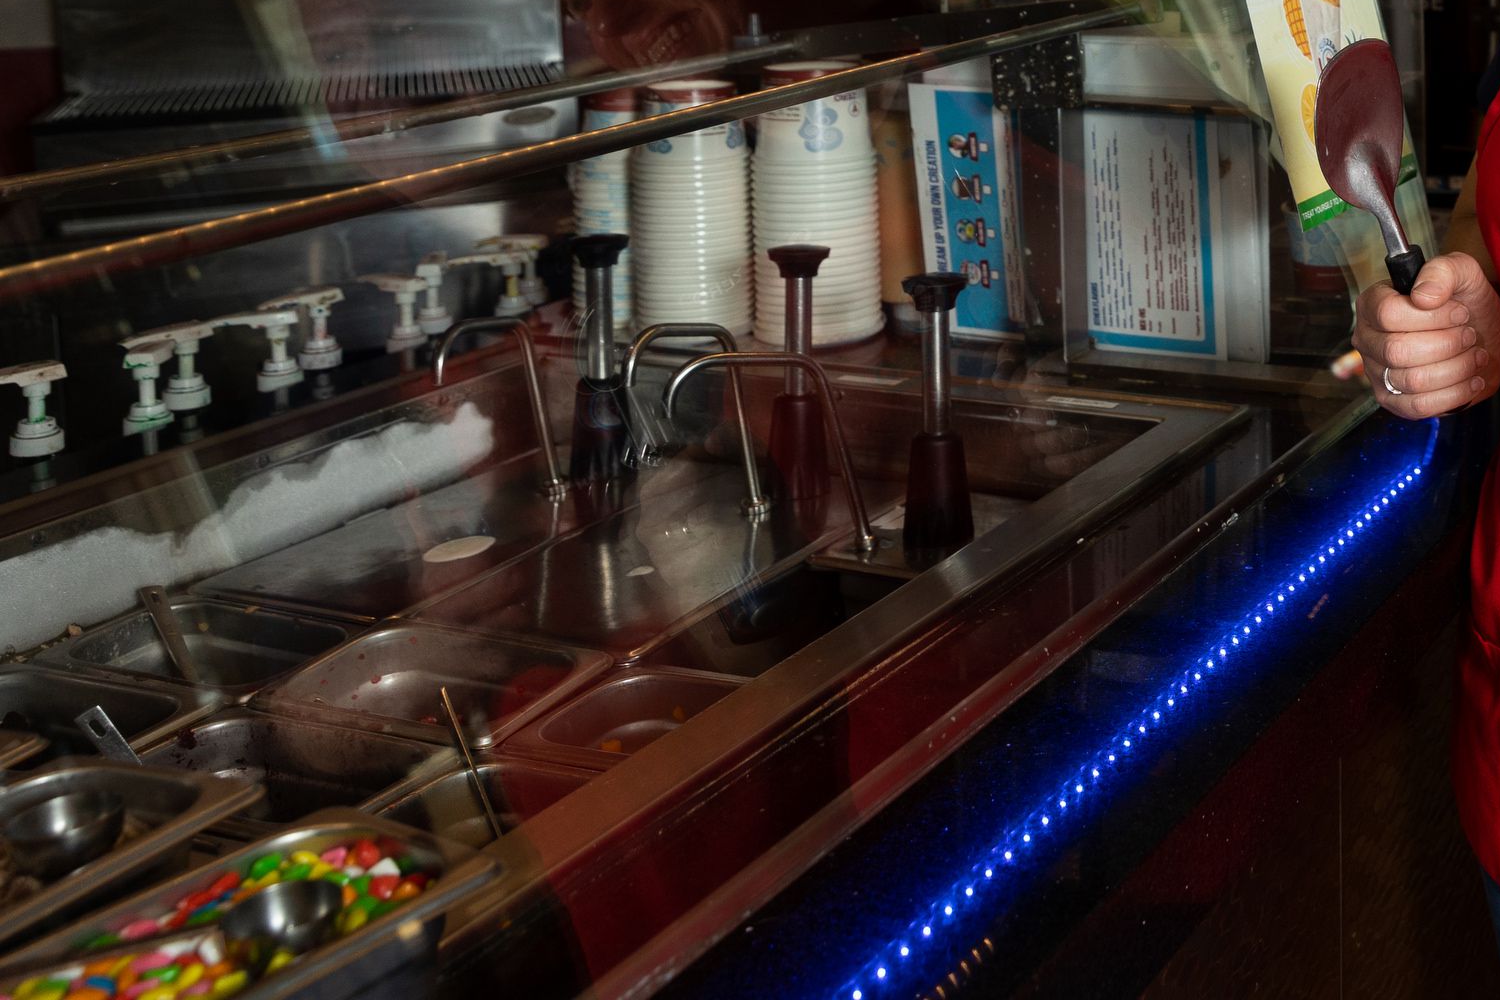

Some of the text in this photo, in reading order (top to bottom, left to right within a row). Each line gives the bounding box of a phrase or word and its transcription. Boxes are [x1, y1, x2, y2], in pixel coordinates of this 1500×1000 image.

[925, 140, 949, 274] REAM UP YOUR OWN CREATION
